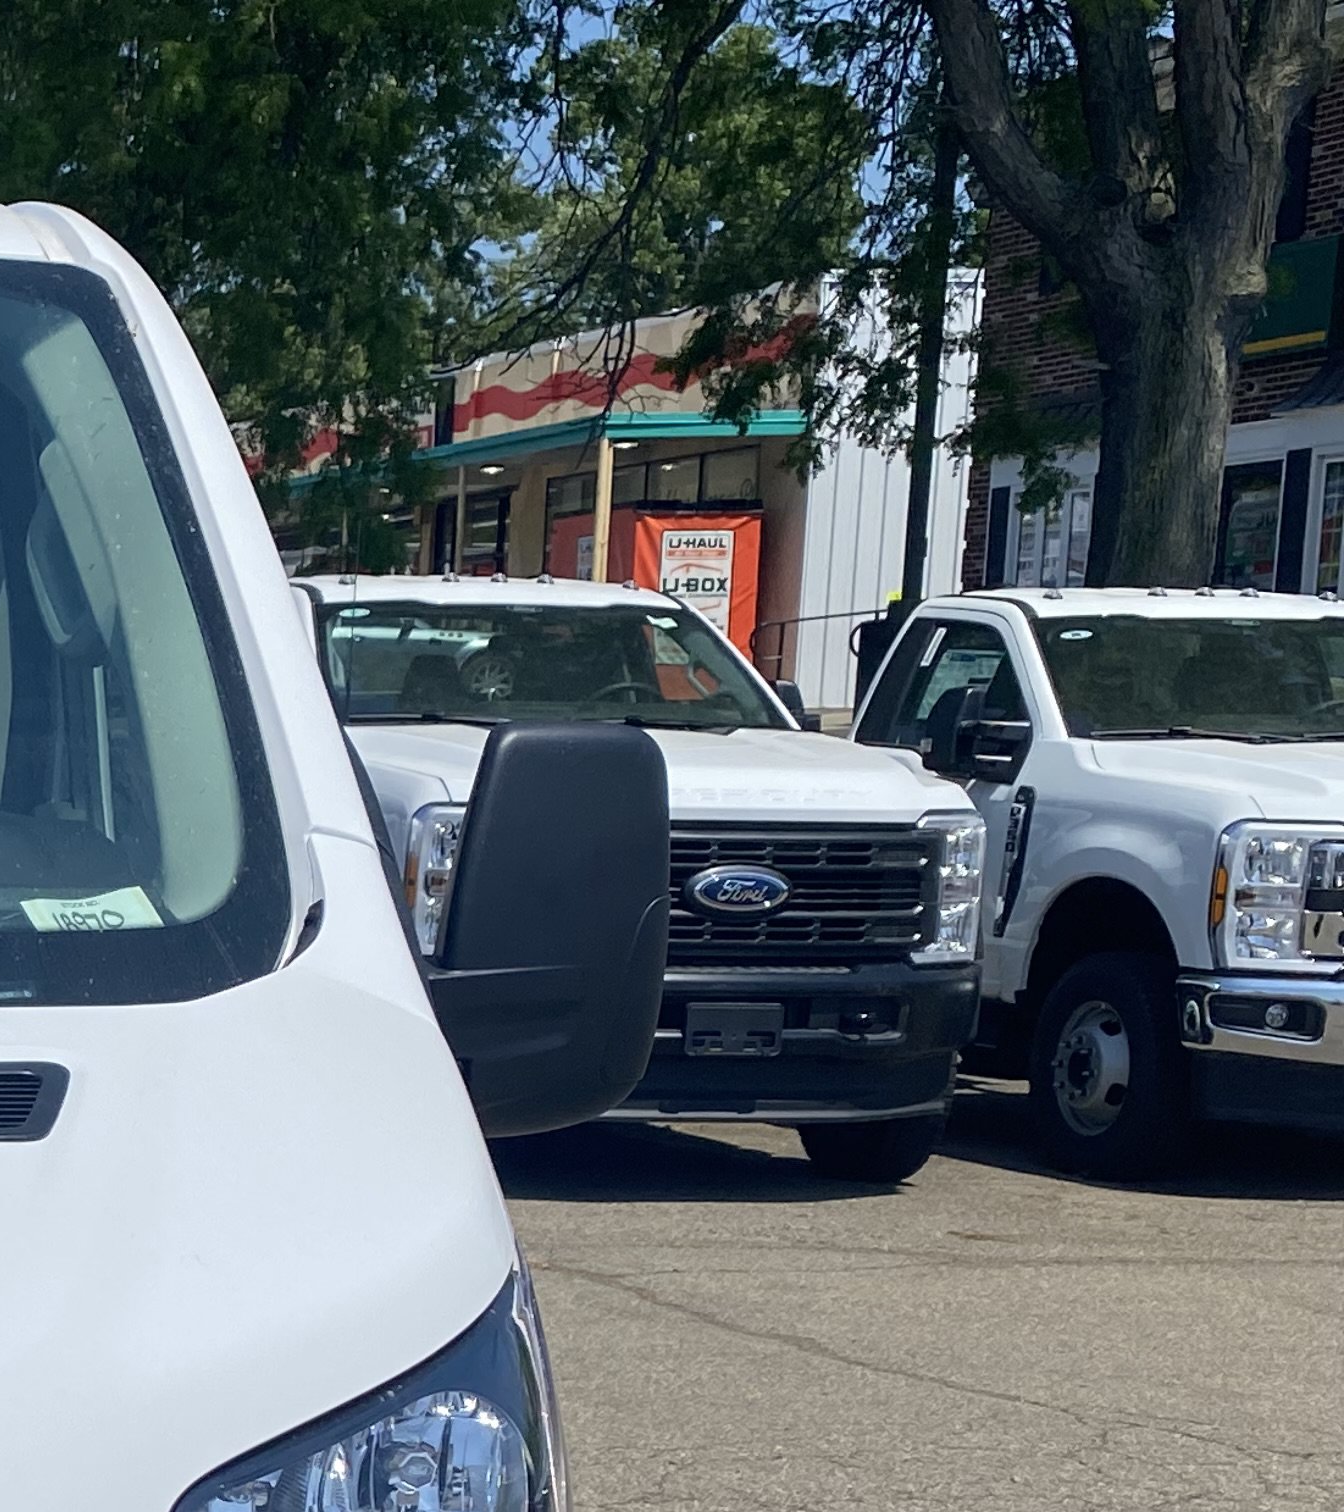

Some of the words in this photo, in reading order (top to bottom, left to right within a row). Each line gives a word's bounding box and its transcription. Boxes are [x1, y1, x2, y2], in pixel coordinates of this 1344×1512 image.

[668, 537, 727, 549] U-HAUL
[662, 577, 728, 593] U-BOX
[717, 880, 769, 902] Ford
